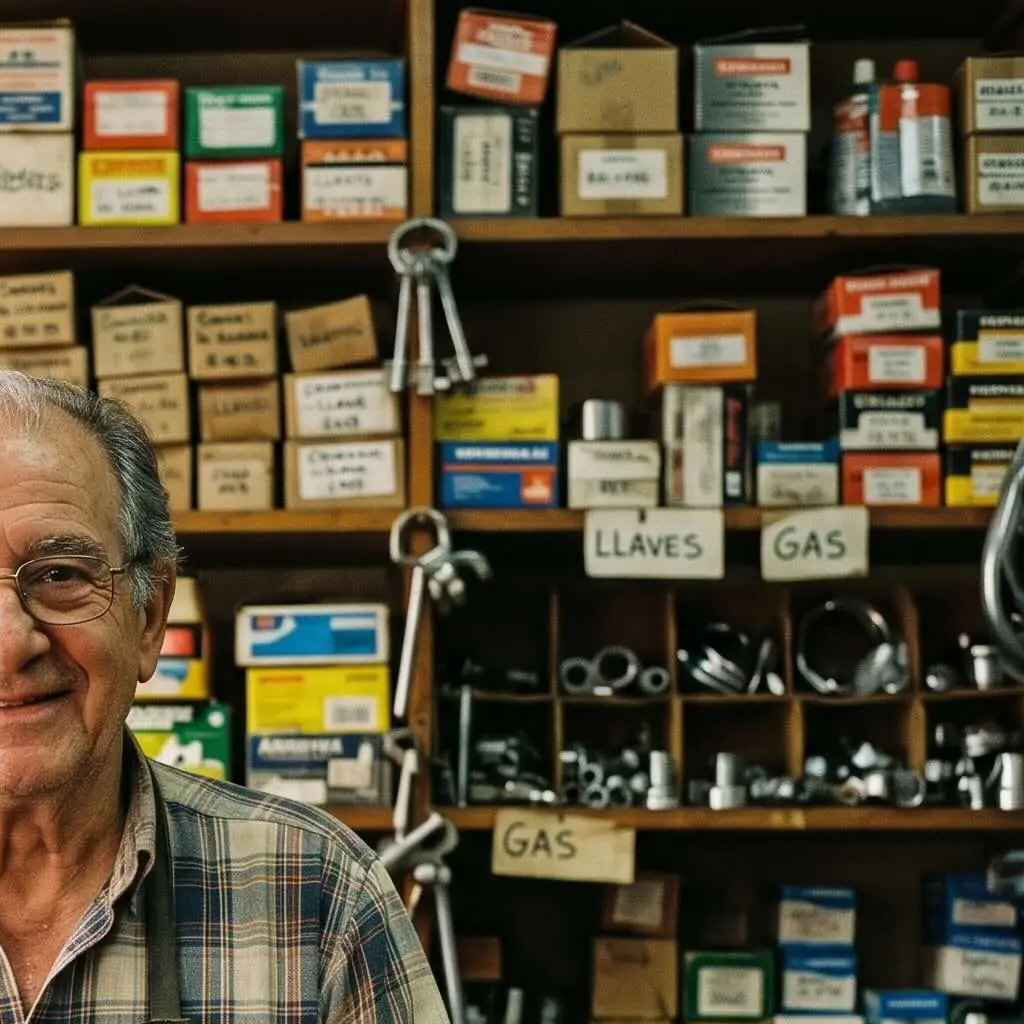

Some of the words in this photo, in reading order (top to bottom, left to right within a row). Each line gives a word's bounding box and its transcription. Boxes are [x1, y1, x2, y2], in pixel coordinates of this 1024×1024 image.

[595, 528, 704, 560] LLAVES
[773, 525, 846, 561] GAS
[503, 821, 578, 859] GAS
